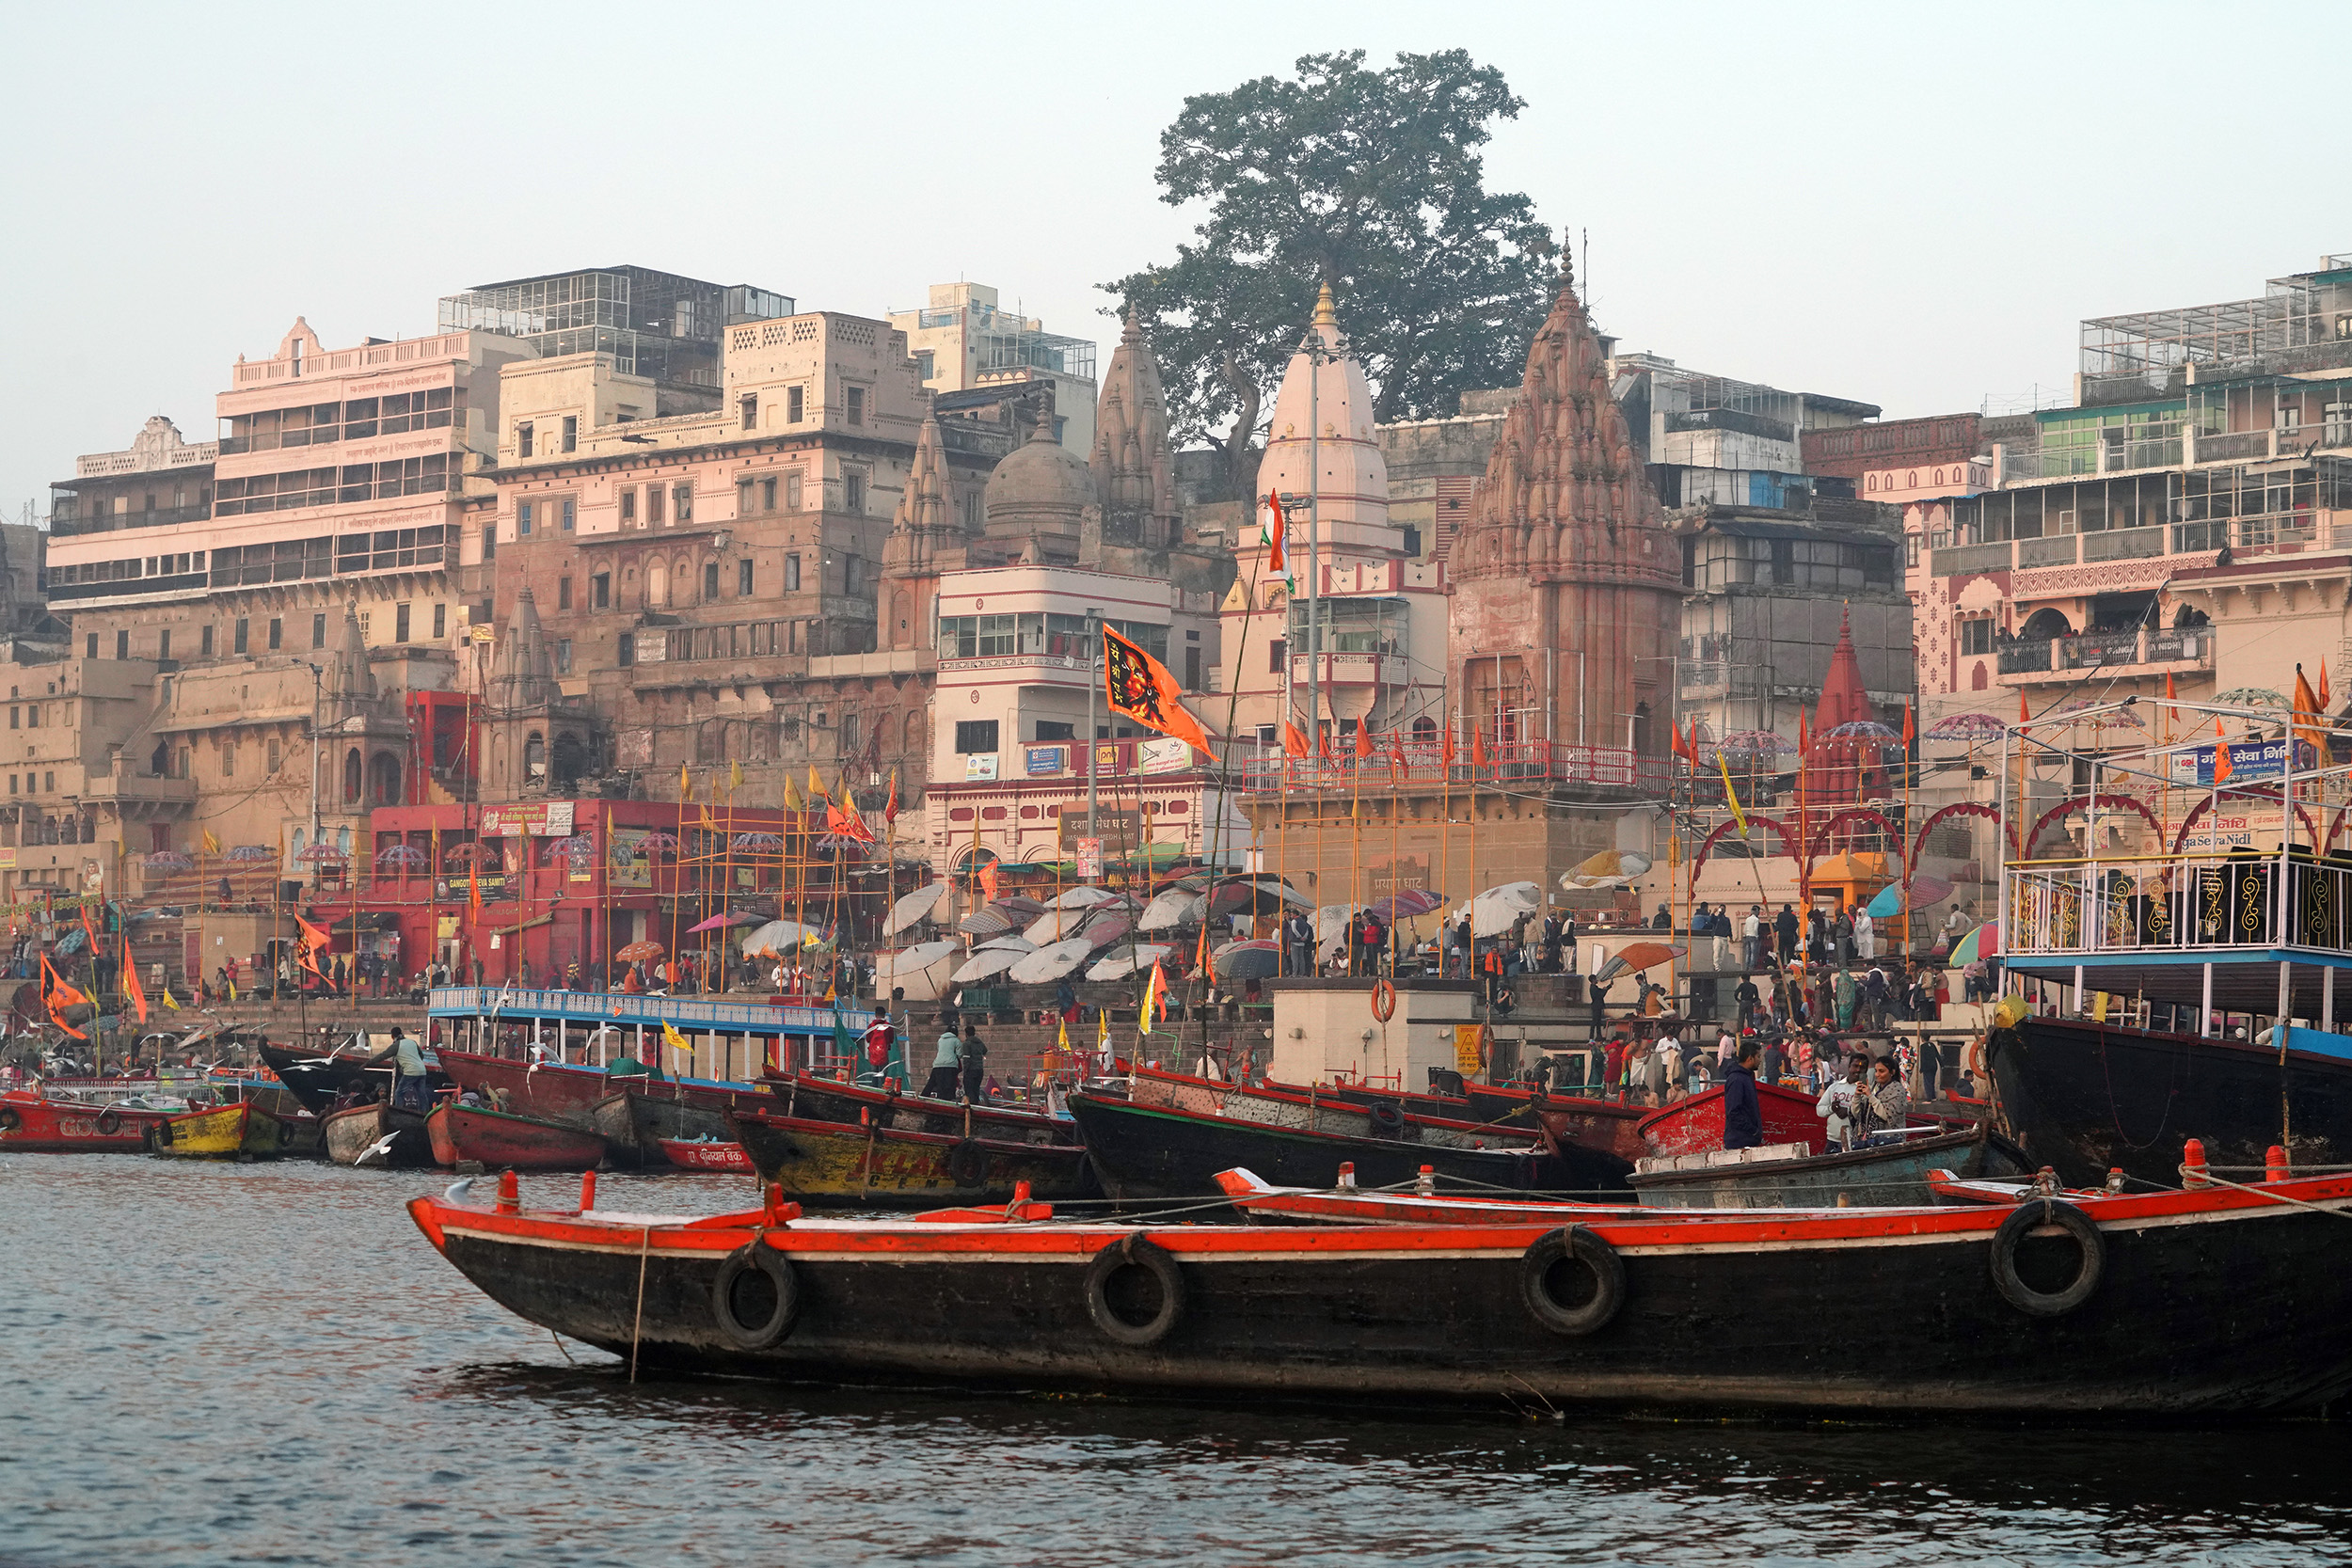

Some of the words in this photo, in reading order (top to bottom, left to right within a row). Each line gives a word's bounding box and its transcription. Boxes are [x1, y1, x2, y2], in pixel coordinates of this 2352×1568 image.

[2233, 749, 2261, 763] सेवा
[2264, 744, 2296, 760] निि
[1112, 818, 1129, 830] घट
[450, 878, 471, 888] GANGOT
[488, 877, 506, 887] SAMITI
[1404, 877, 1422, 889] घाट
